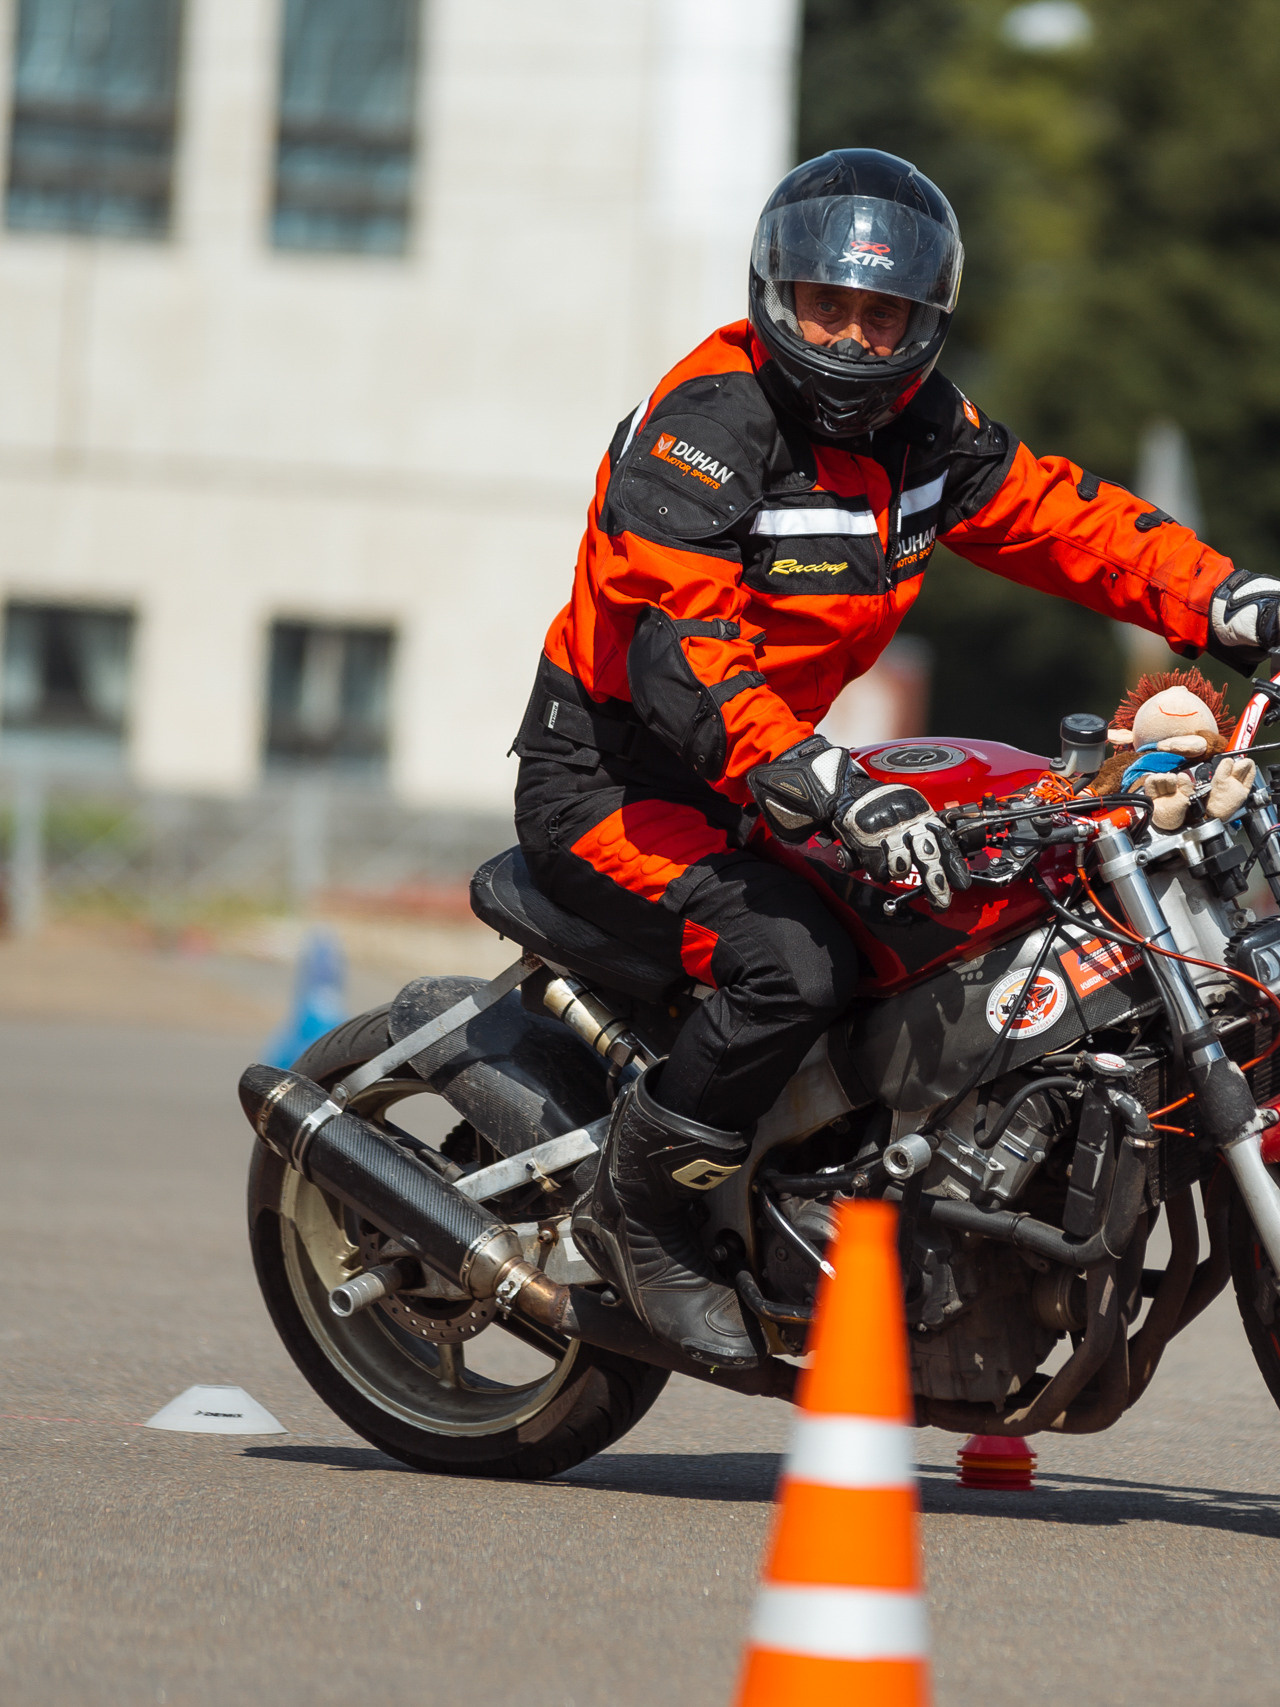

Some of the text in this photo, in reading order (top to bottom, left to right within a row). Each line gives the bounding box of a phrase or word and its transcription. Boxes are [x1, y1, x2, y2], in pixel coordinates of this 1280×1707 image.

[838, 251, 895, 271] XTR
[664, 455, 721, 490] MOTOR SPORTS
[671, 440, 735, 484] DUHAN
[769, 558, 849, 576] Racing
[1079, 973, 1104, 991] КУБОК
[1102, 952, 1143, 979] ФЕДЕРАЦИИ
